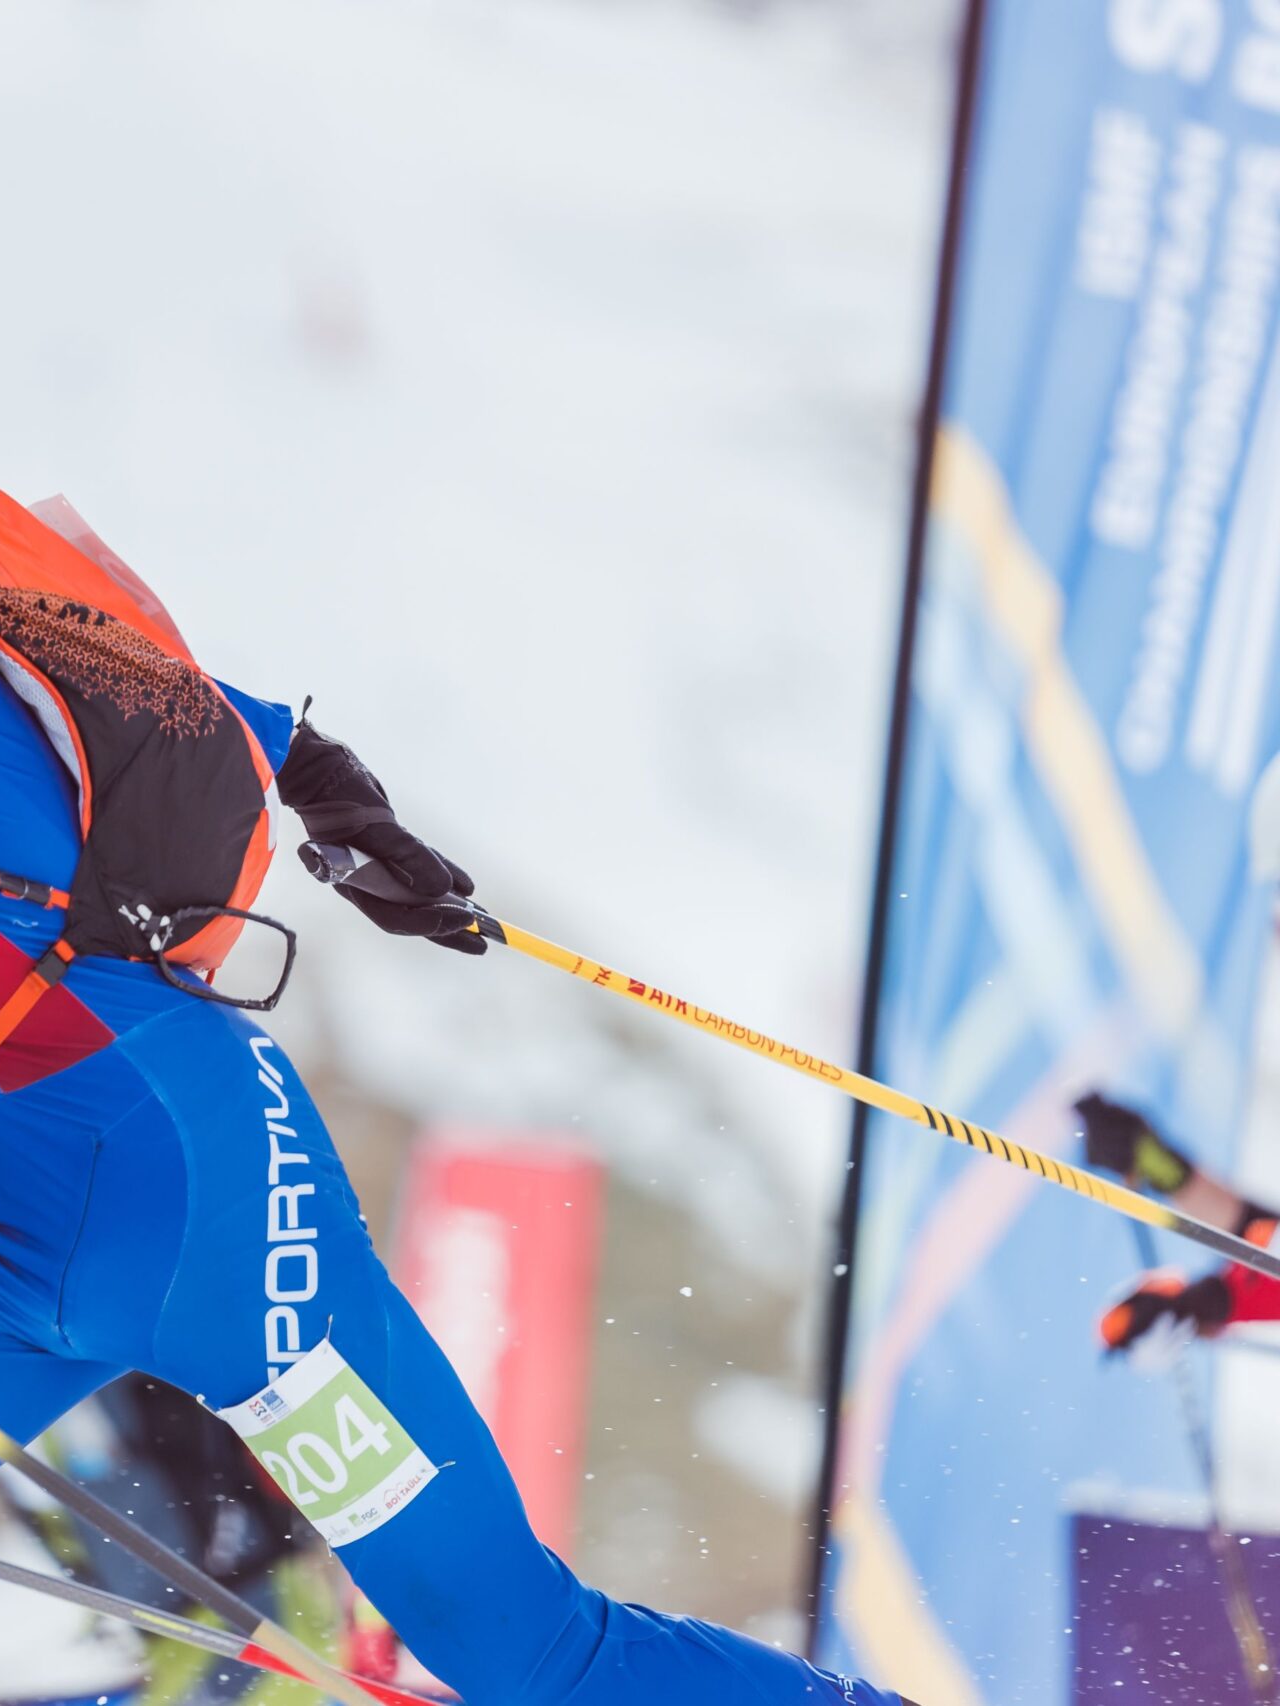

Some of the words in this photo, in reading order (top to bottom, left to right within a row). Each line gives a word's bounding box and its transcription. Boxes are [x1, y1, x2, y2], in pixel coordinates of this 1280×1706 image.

[693, 1005, 777, 1053] CARBON
[779, 1042, 844, 1082] POLES
[248, 1036, 319, 1386] PORTIVA
[260, 1393, 393, 1507] 204
